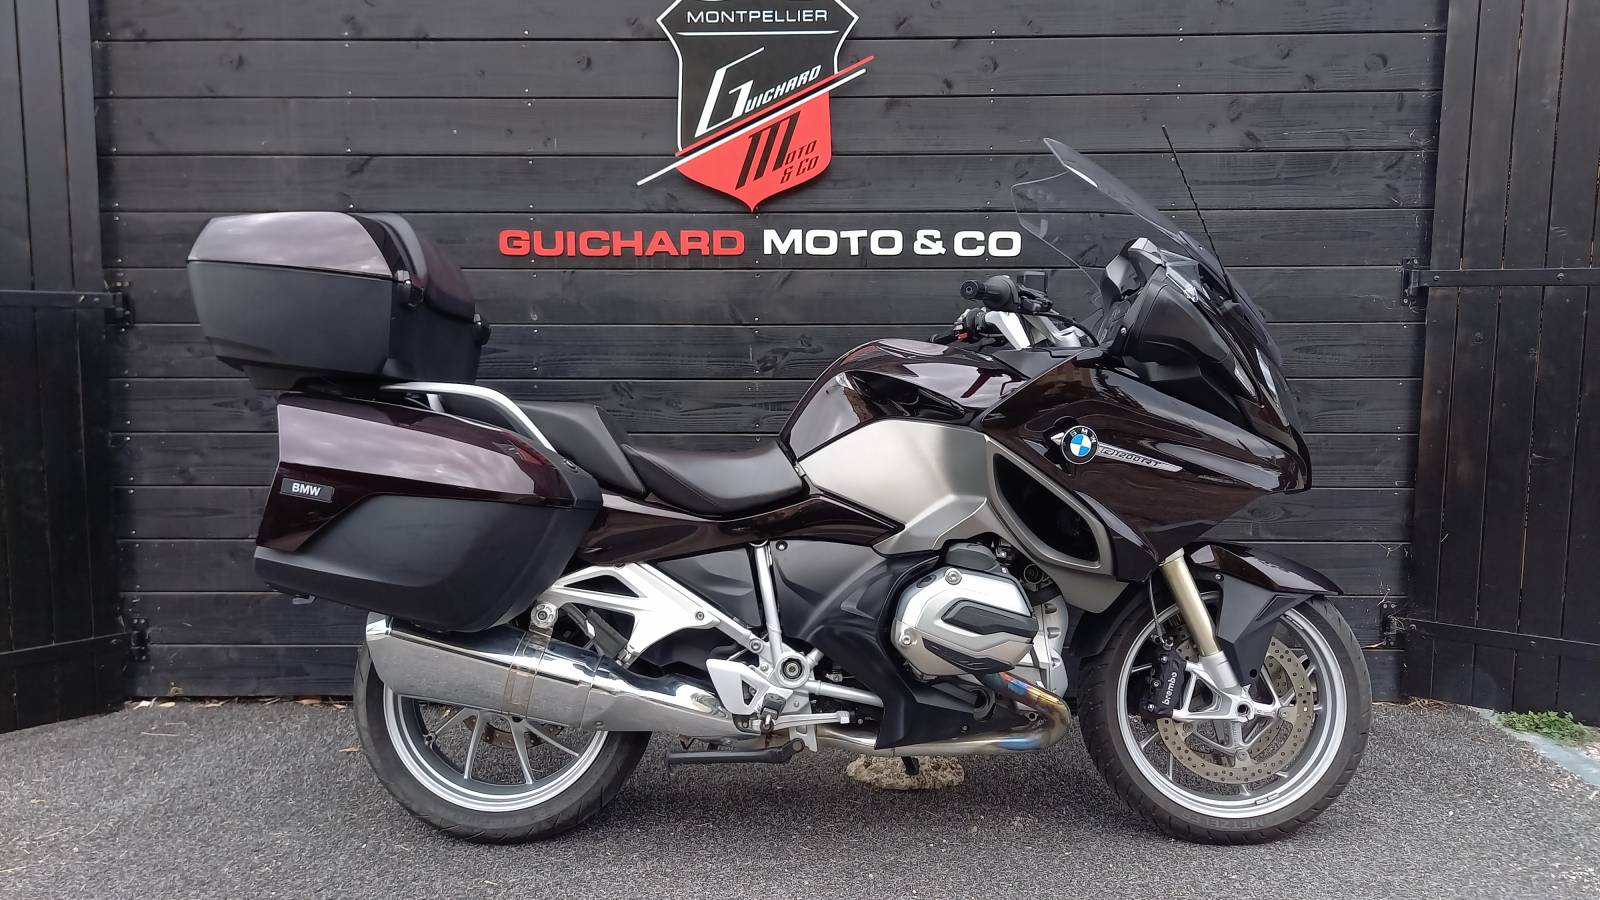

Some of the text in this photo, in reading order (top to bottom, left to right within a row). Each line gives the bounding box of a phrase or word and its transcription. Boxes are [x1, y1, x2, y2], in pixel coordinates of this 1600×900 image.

[686, 9, 828, 24] MONTPELLIER
[694, 46, 822, 138] GUICHARD
[734, 110, 817, 191] MOTO
[780, 155, 819, 185] & CO
[499, 228, 1022, 257] GUICHARD MOTO & CO
[1070, 427, 1097, 443] BMW
[292, 482, 321, 497] BMW
[1162, 672, 1178, 706] brembo
